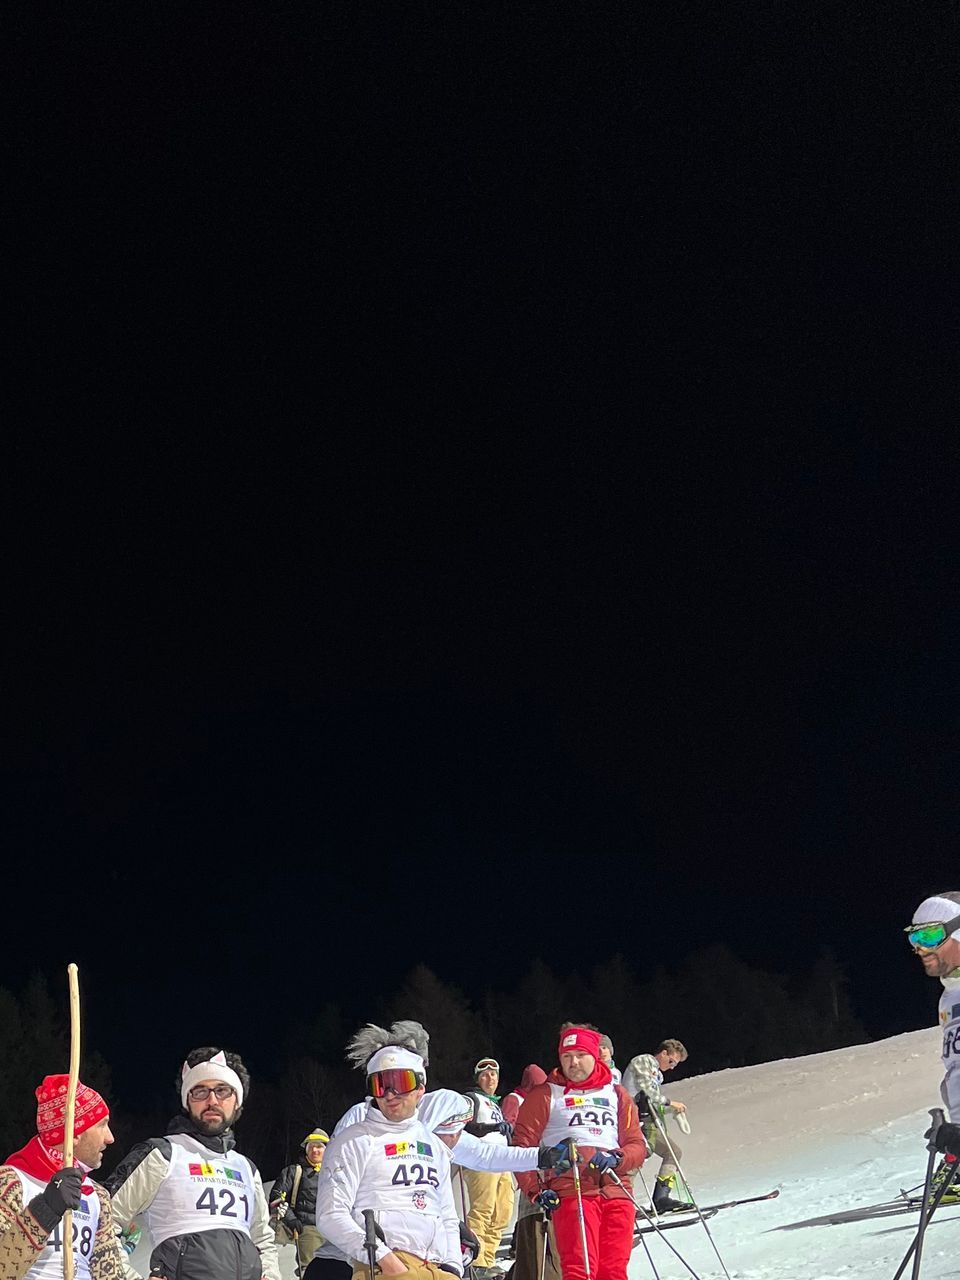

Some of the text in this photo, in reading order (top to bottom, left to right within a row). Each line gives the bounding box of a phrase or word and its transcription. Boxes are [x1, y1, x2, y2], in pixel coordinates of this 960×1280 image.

[568, 1111, 615, 1126] 436
[391, 1163, 440, 1190] 425
[196, 1187, 249, 1222] 421
